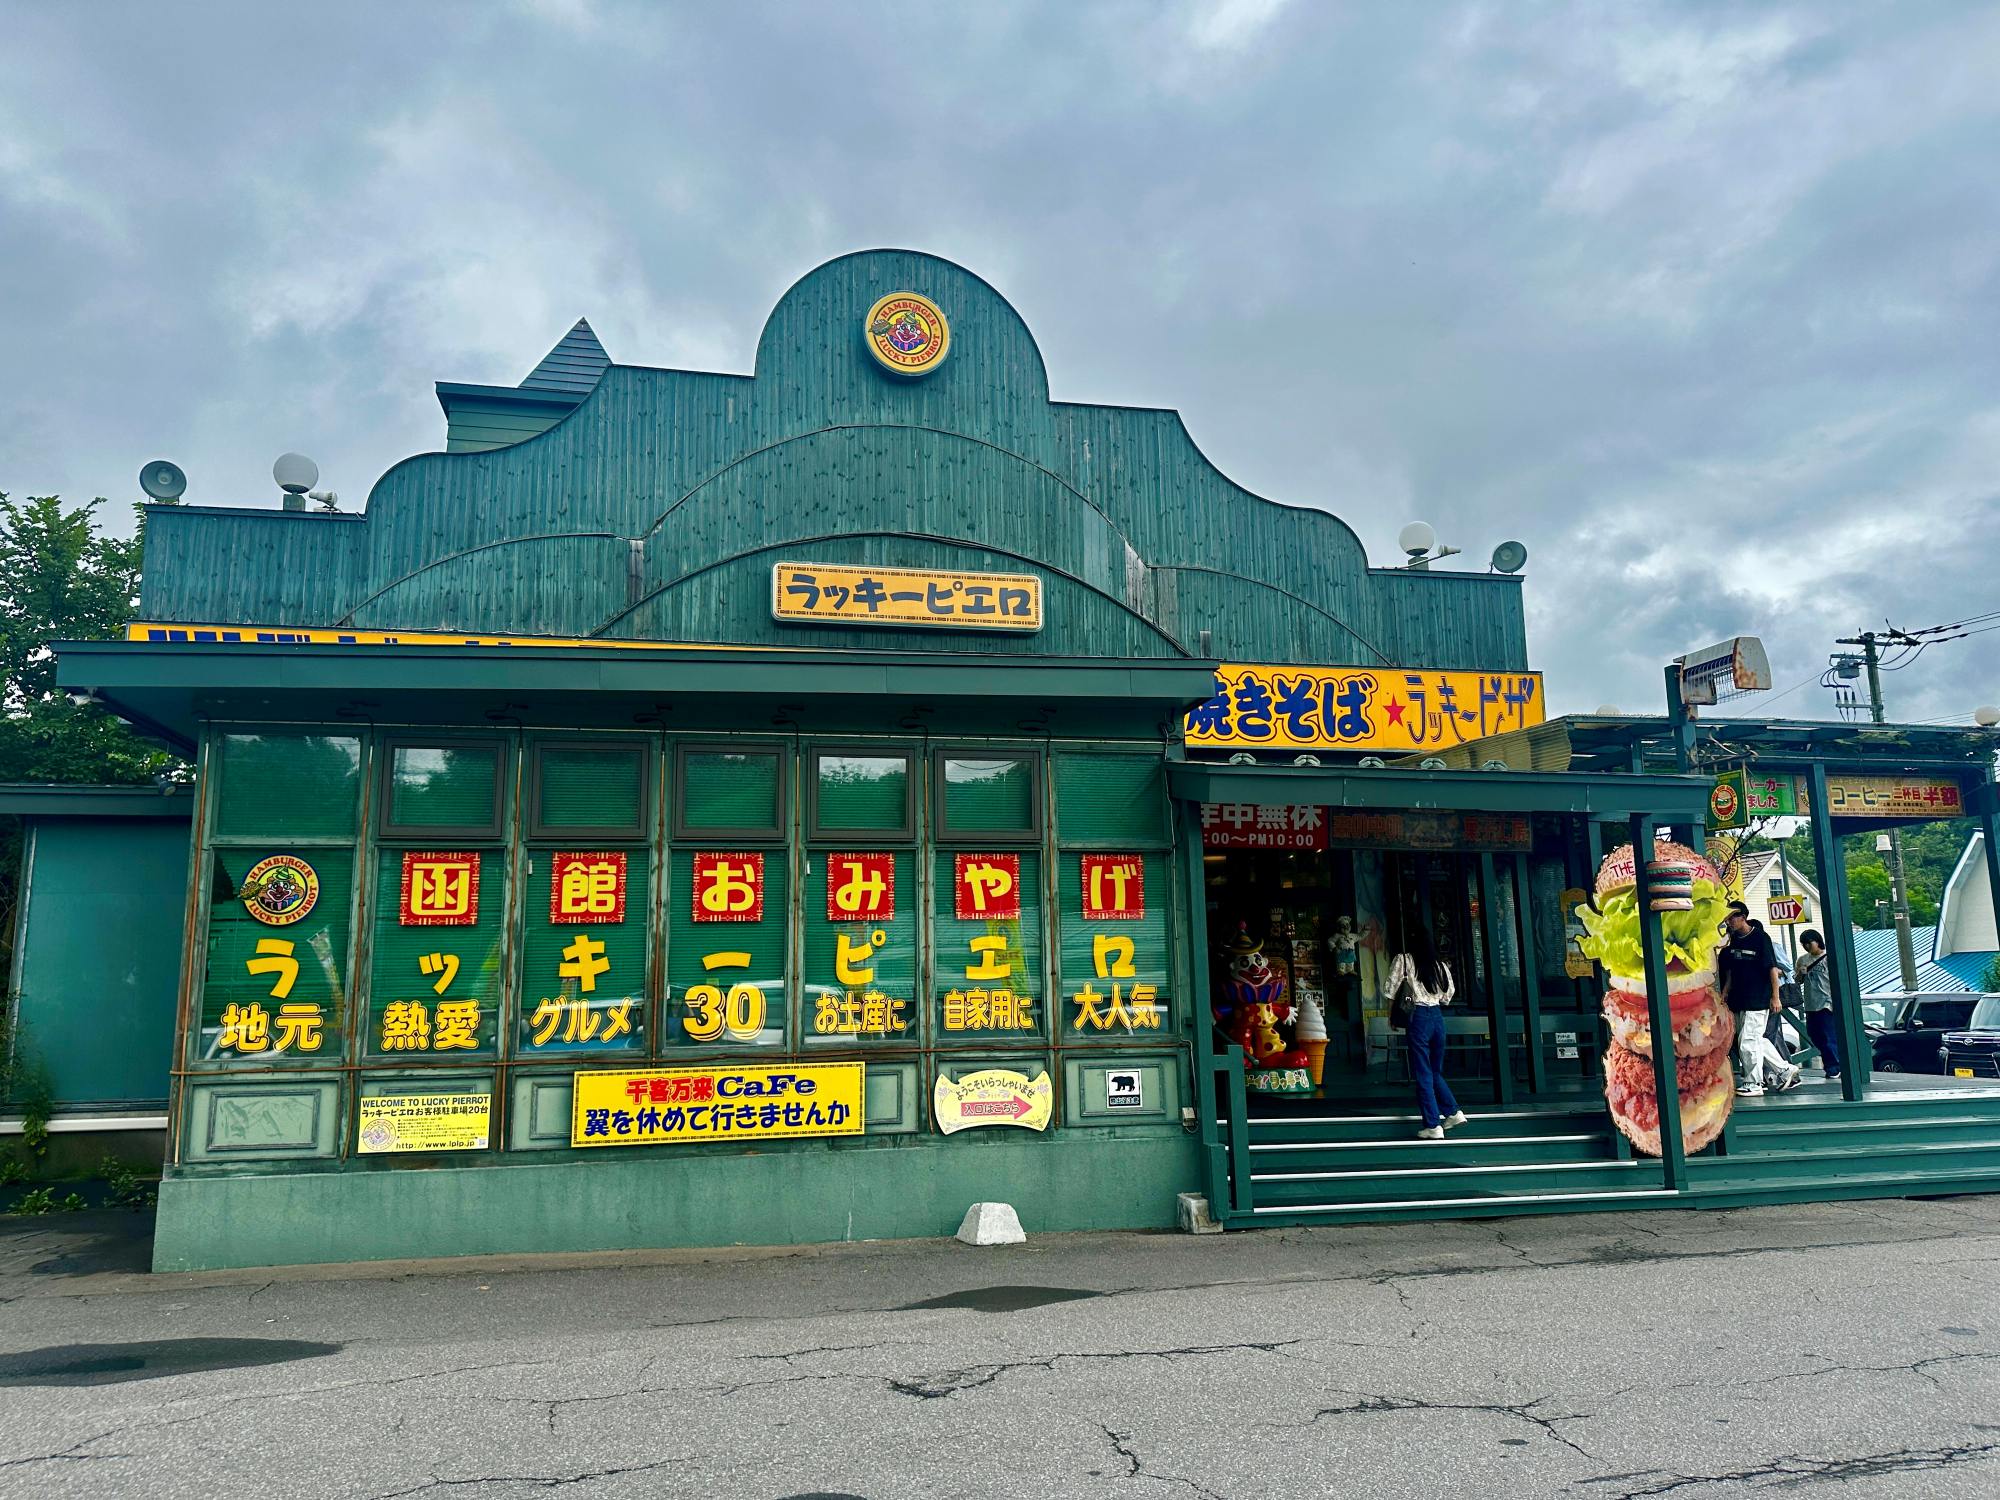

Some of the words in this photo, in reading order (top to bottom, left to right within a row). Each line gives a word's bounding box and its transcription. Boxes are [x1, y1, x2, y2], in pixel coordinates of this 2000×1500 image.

[881, 302, 937, 326] HAMBURGER
[879, 338, 909, 363] LUCKY
[910, 334, 939, 363] PIERROT
[786, 574, 1031, 616] ラッキーピエロ
[250, 857, 313, 880] HAMBURGER
[1610, 861, 1635, 877] THE
[249, 903, 282, 923] LUCKY
[285, 886, 317, 922] PIERROT
[1771, 903, 1794, 919] OUT
[219, 1002, 323, 1052] 地元
[381, 999, 480, 1051] 熱愛
[530, 995, 632, 1046] グルメ
[683, 984, 766, 1041] 30
[814, 990, 907, 1034] お土産に
[944, 987, 1033, 1031] 自家用に
[1073, 982, 1160, 1030] 大人気
[956, 1077, 1036, 1101] ようこそいらっしゃいませ
[362, 1099, 405, 1108] WELCOME
[408, 1098, 419, 1107] TO
[421, 1097, 450, 1106] LUCKY
[452, 1096, 489, 1105] PIERROT
[963, 1101, 1020, 1115] 入口はこちら
[584, 1101, 850, 1137] 翼を休めて行きませんか
